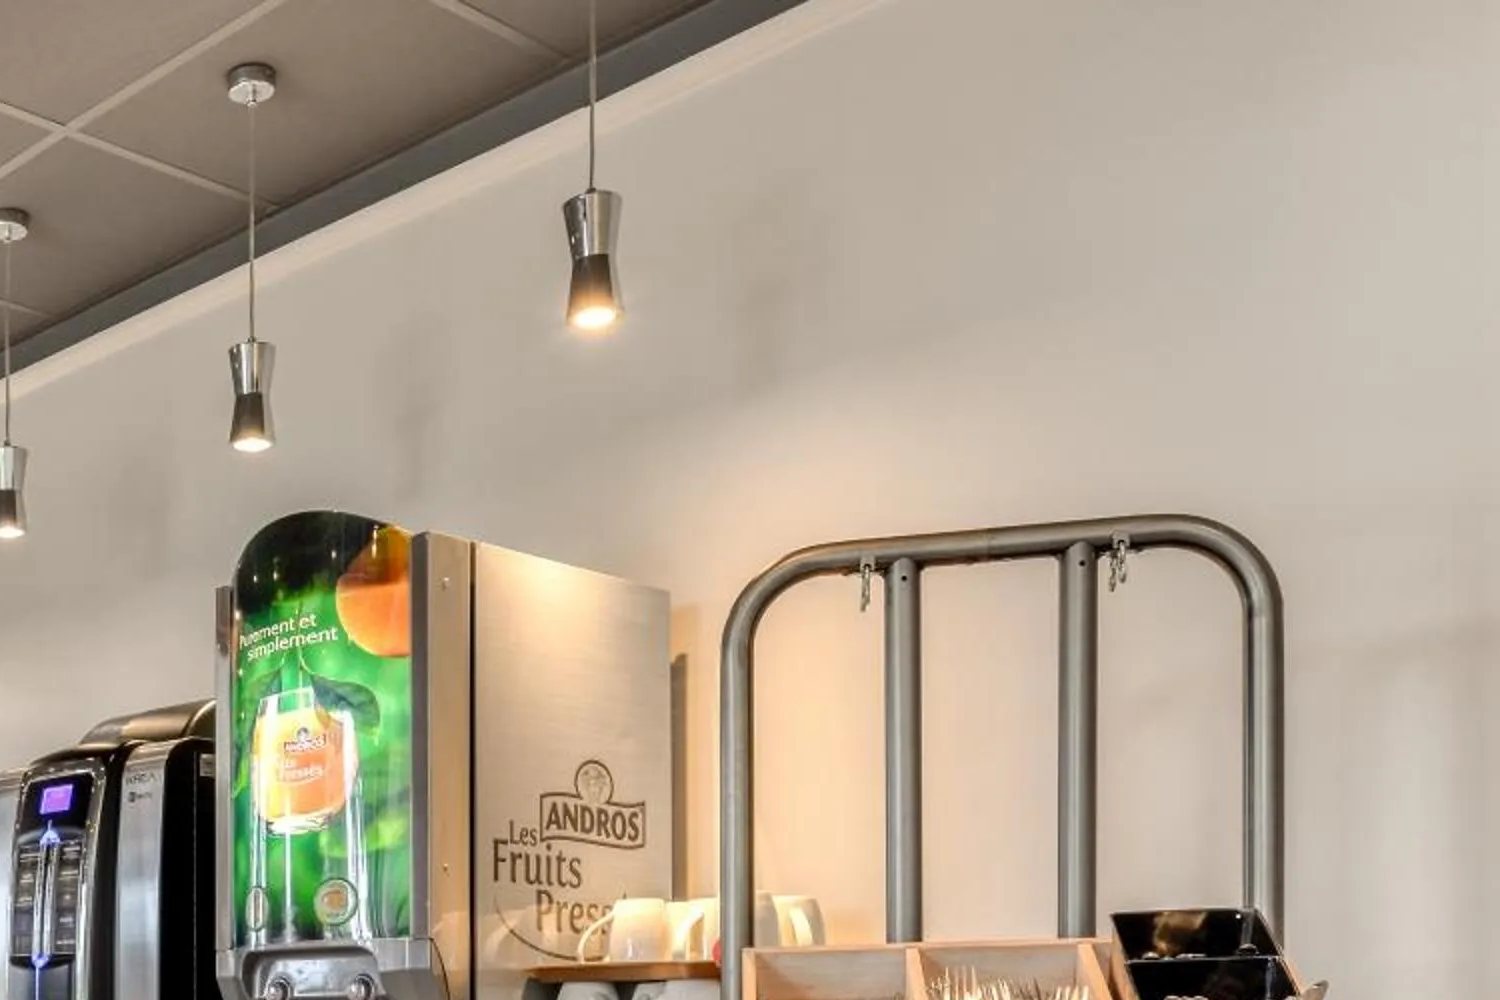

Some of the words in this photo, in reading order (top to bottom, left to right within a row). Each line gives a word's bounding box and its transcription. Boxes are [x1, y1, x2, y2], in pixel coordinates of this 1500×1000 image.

[299, 613, 317, 630] et
[247, 627, 338, 662] simplement
[509, 819, 538, 847] Les
[545, 801, 641, 842] ANDROS
[493, 838, 583, 889] Fruits
[536, 888, 614, 935] Press
